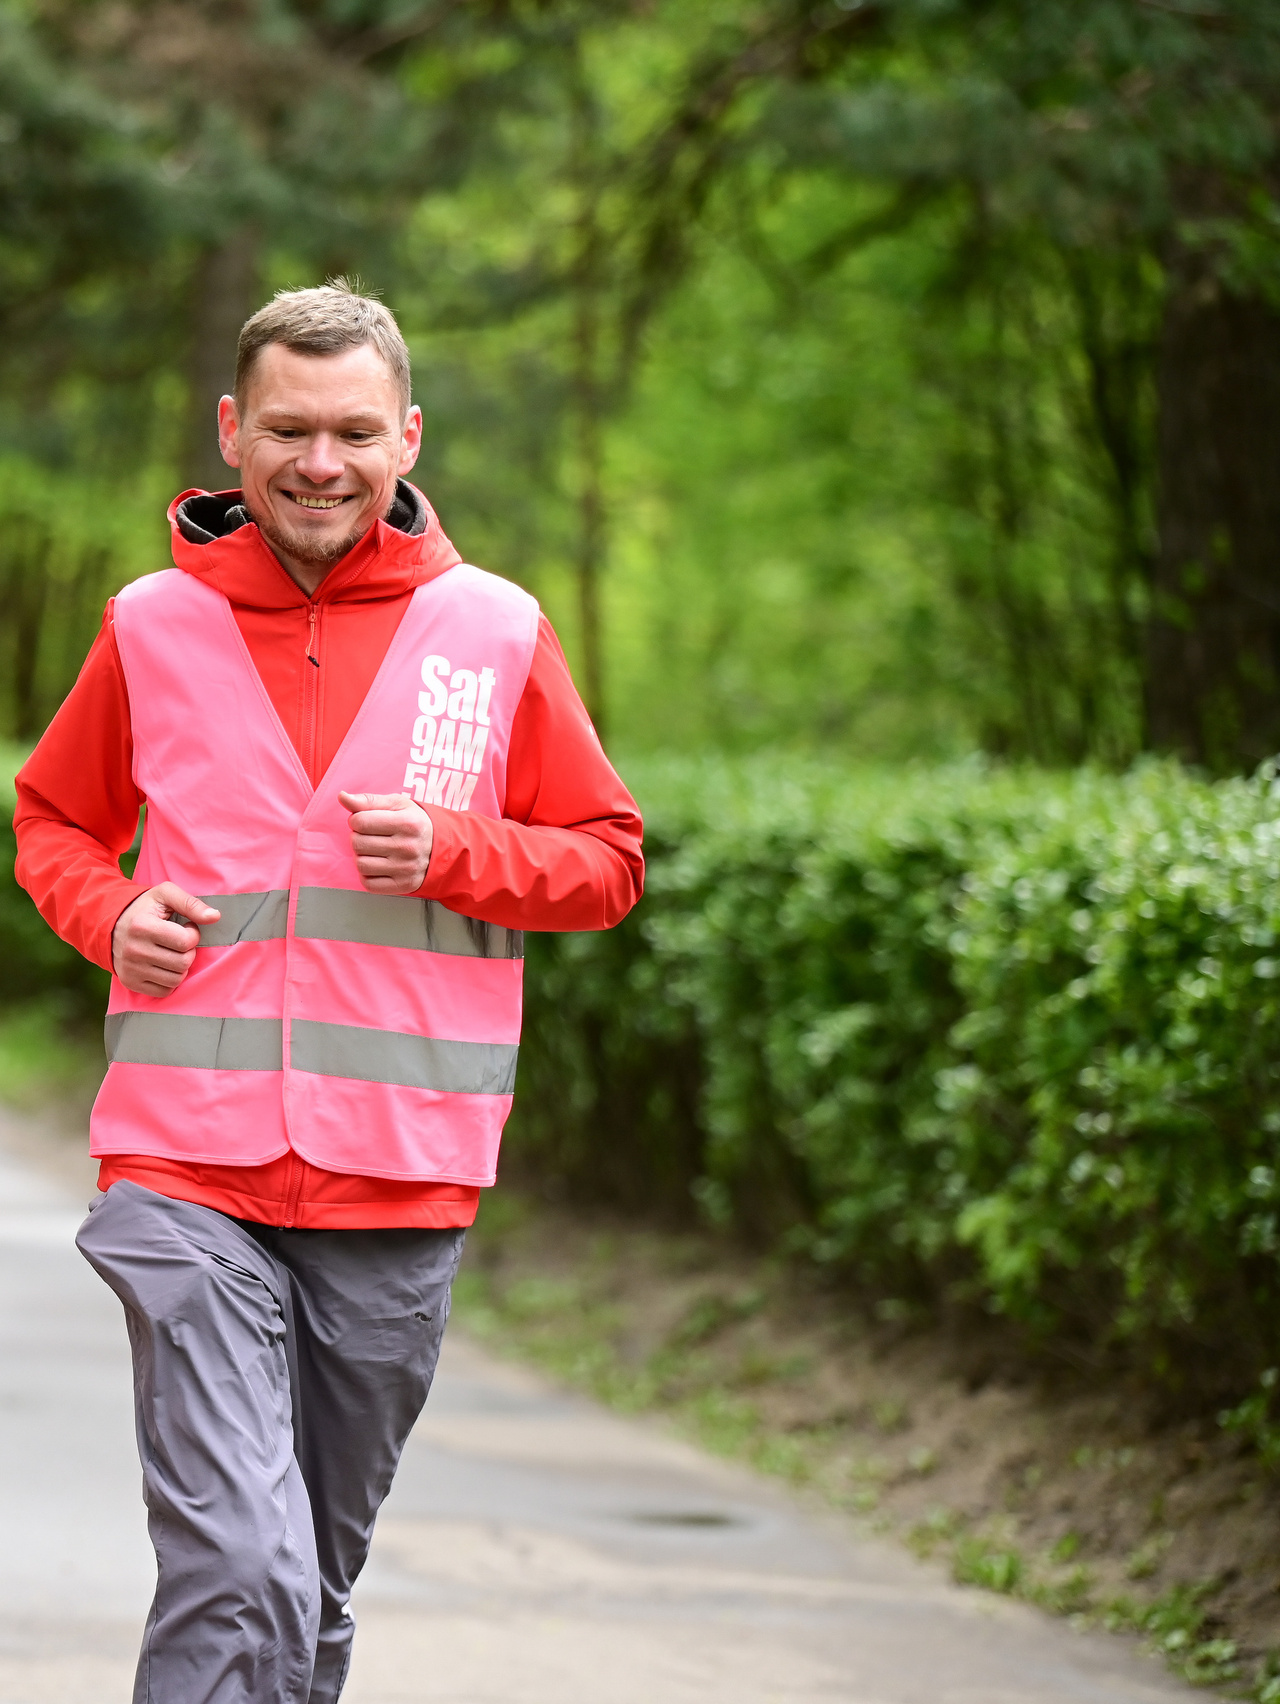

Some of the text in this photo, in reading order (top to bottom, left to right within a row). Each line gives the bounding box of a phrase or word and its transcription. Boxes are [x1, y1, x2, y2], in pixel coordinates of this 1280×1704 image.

[418, 655, 495, 725] Sat
[410, 715, 488, 773] 9AM
[401, 764, 477, 811] 5KM
